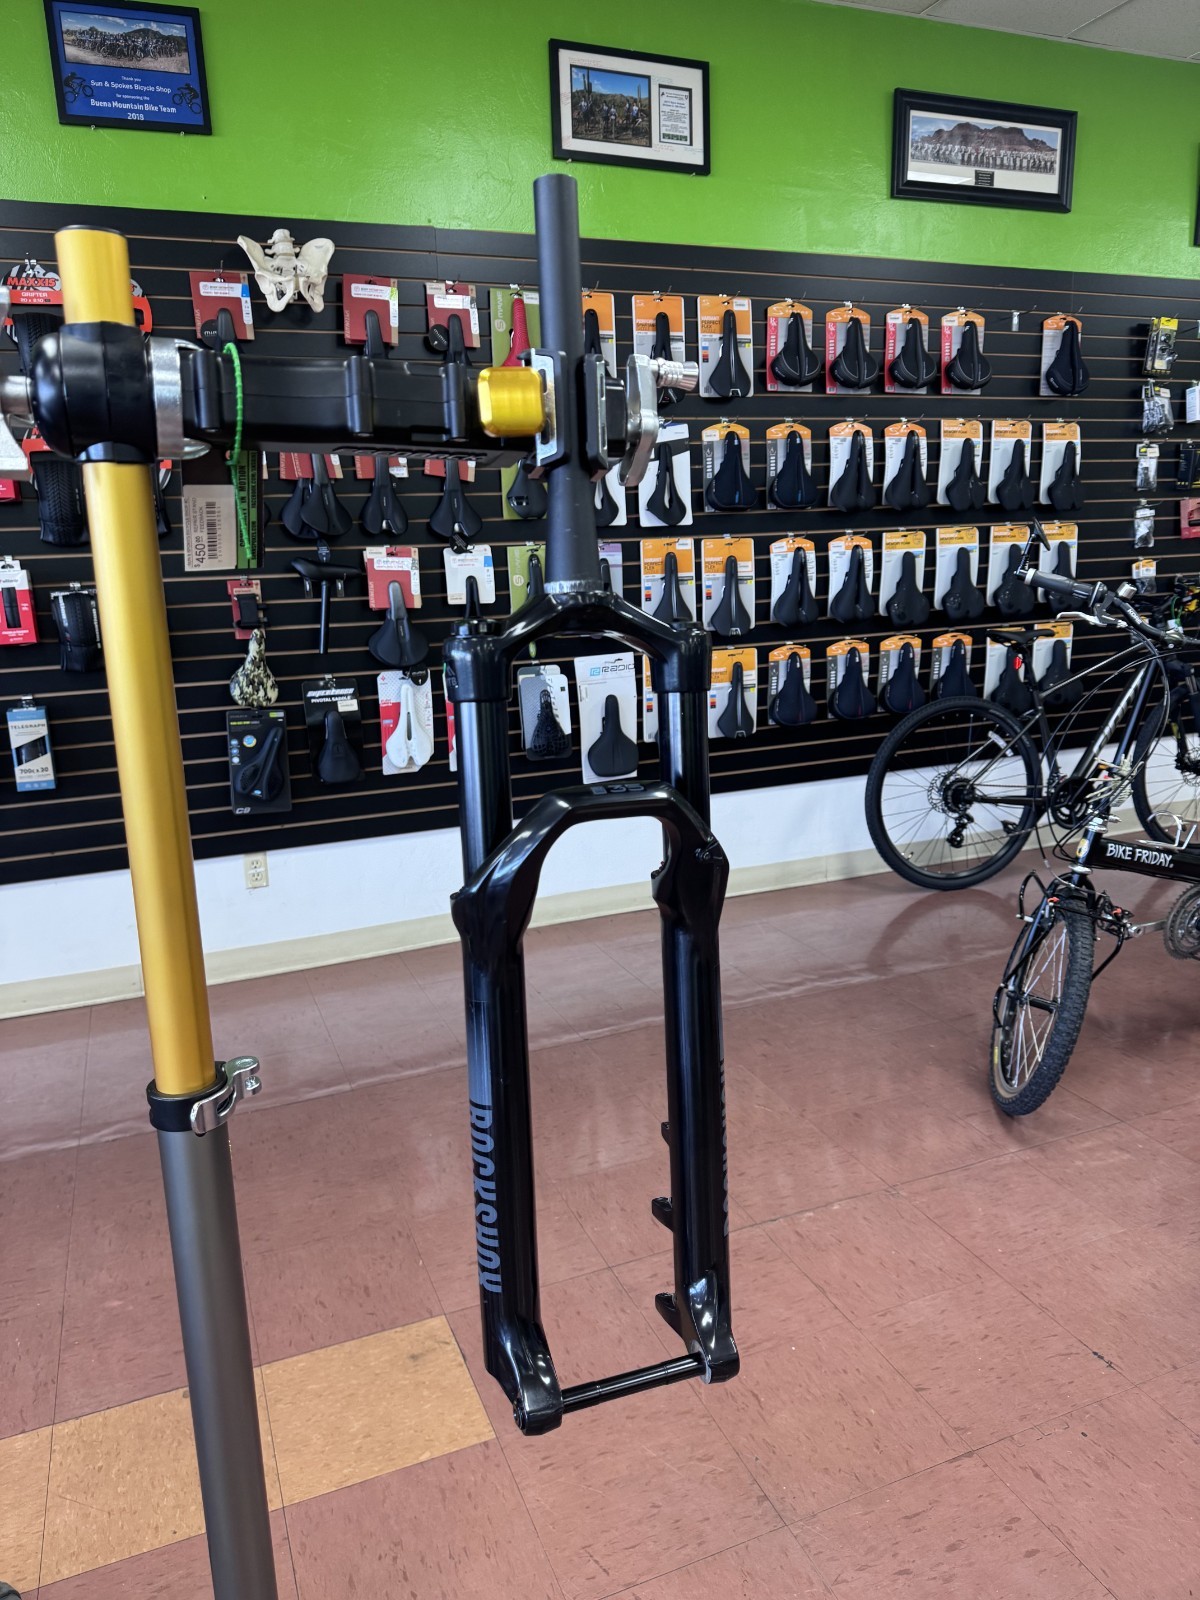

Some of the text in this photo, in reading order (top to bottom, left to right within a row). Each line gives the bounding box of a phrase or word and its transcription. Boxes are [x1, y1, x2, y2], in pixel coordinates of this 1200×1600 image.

[110, 82, 133, 90] Spokes
[134, 84, 155, 92] Bicycle
[155, 86, 171, 94] Shop
[90, 99, 177, 113] Buena Mountain Bike Team
[7, 276, 57, 287] MAXXIS
[238, 465, 247, 492] MOTION
[10, 722, 46, 731] TELEGRAPH
[1106, 843, 1133, 860] BIKE
[468, 1103, 503, 1294] ROCKSHOX
